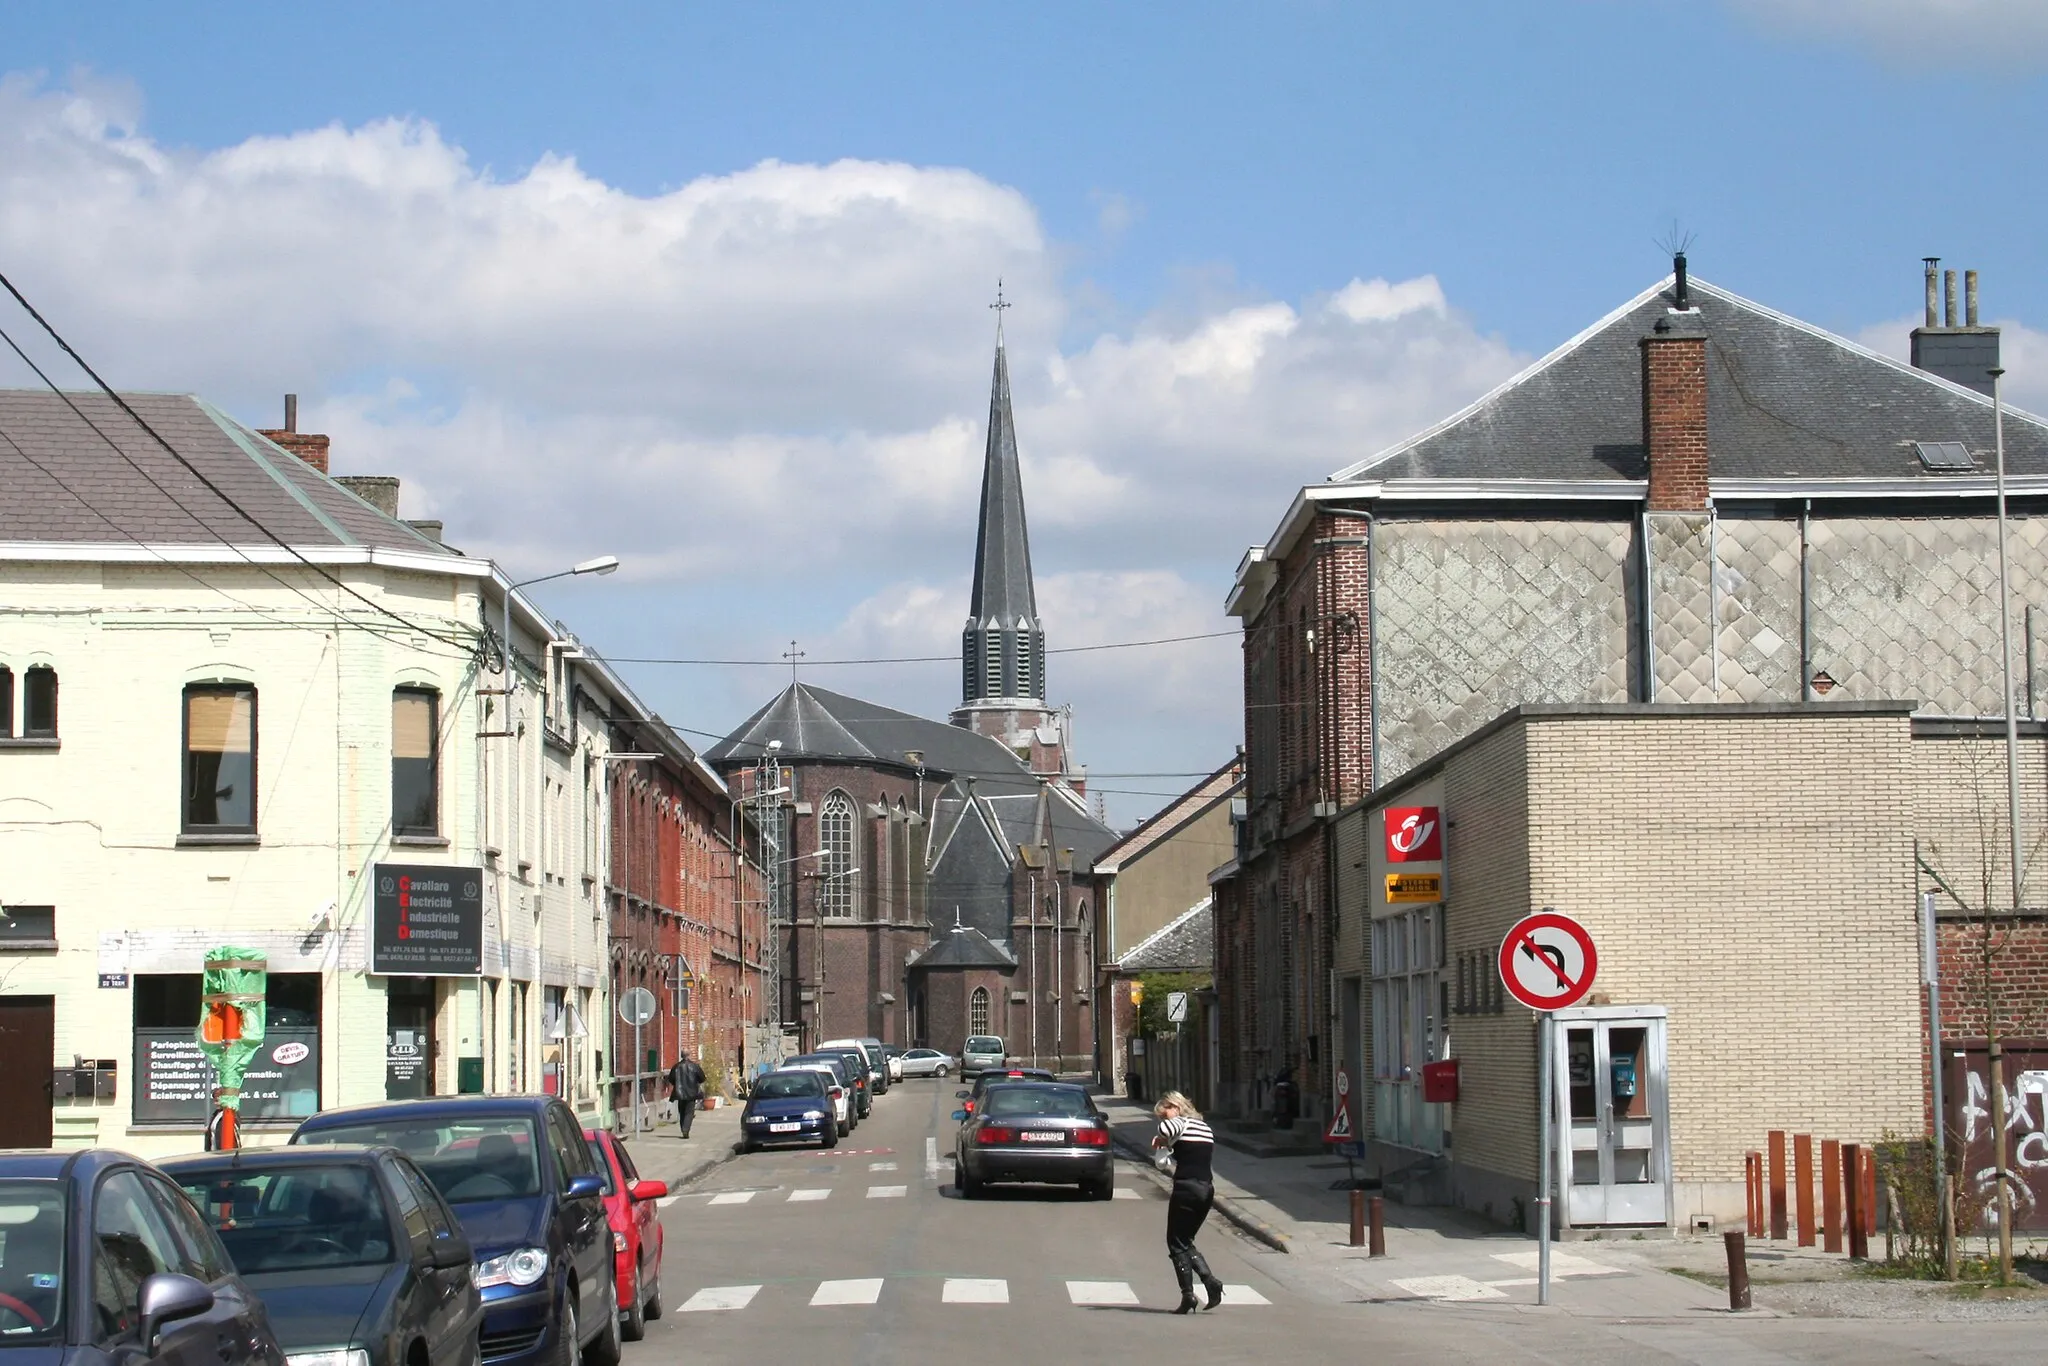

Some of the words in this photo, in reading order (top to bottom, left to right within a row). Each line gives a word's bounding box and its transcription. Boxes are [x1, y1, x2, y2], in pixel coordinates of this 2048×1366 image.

[399, 875, 450, 892] Cavallaro
[399, 893, 453, 909] Electricité
[400, 909, 460, 924] Industrielle
[398, 925, 459, 941] Domestique
[151, 1041, 199, 1050] Parlophoni
[151, 1051, 206, 1060] Surveillance
[278, 1050, 305, 1061] GRATUIT
[151, 1060, 196, 1070] Chauffage
[151, 1070, 200, 1079] Installation
[151, 1080, 200, 1090] Dépannage
[151, 1092, 193, 1100] Eclairage
[262, 1091, 279, 1099] ext.
